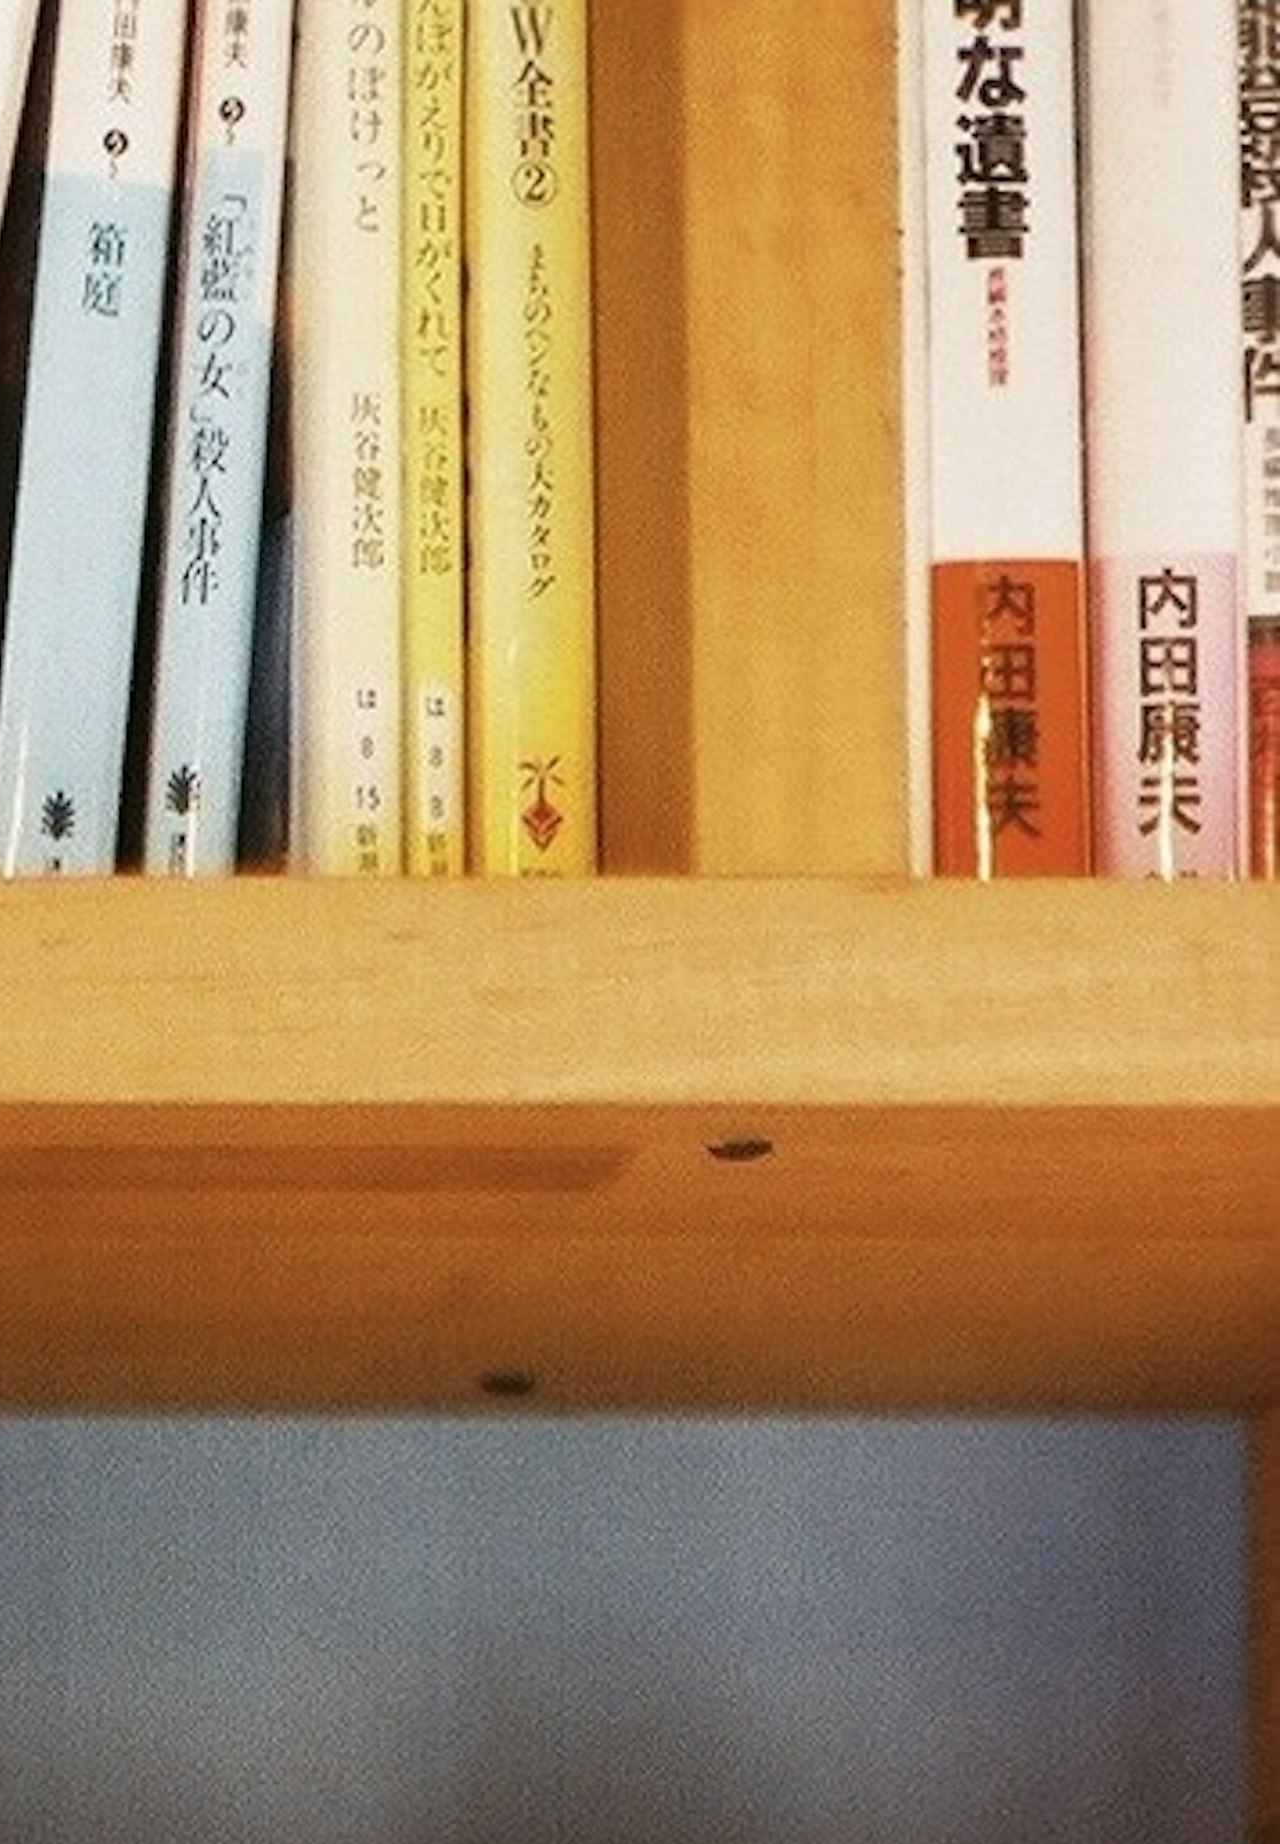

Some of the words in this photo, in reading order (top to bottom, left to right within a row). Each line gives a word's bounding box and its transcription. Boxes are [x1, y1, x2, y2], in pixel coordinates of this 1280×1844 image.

[82, 220, 130, 319] 箱庭
[349, 391, 387, 571] 灰谷健次郎
[979, 572, 1042, 839] 内田康夫
[1136, 567, 1204, 838] 内田康夫
